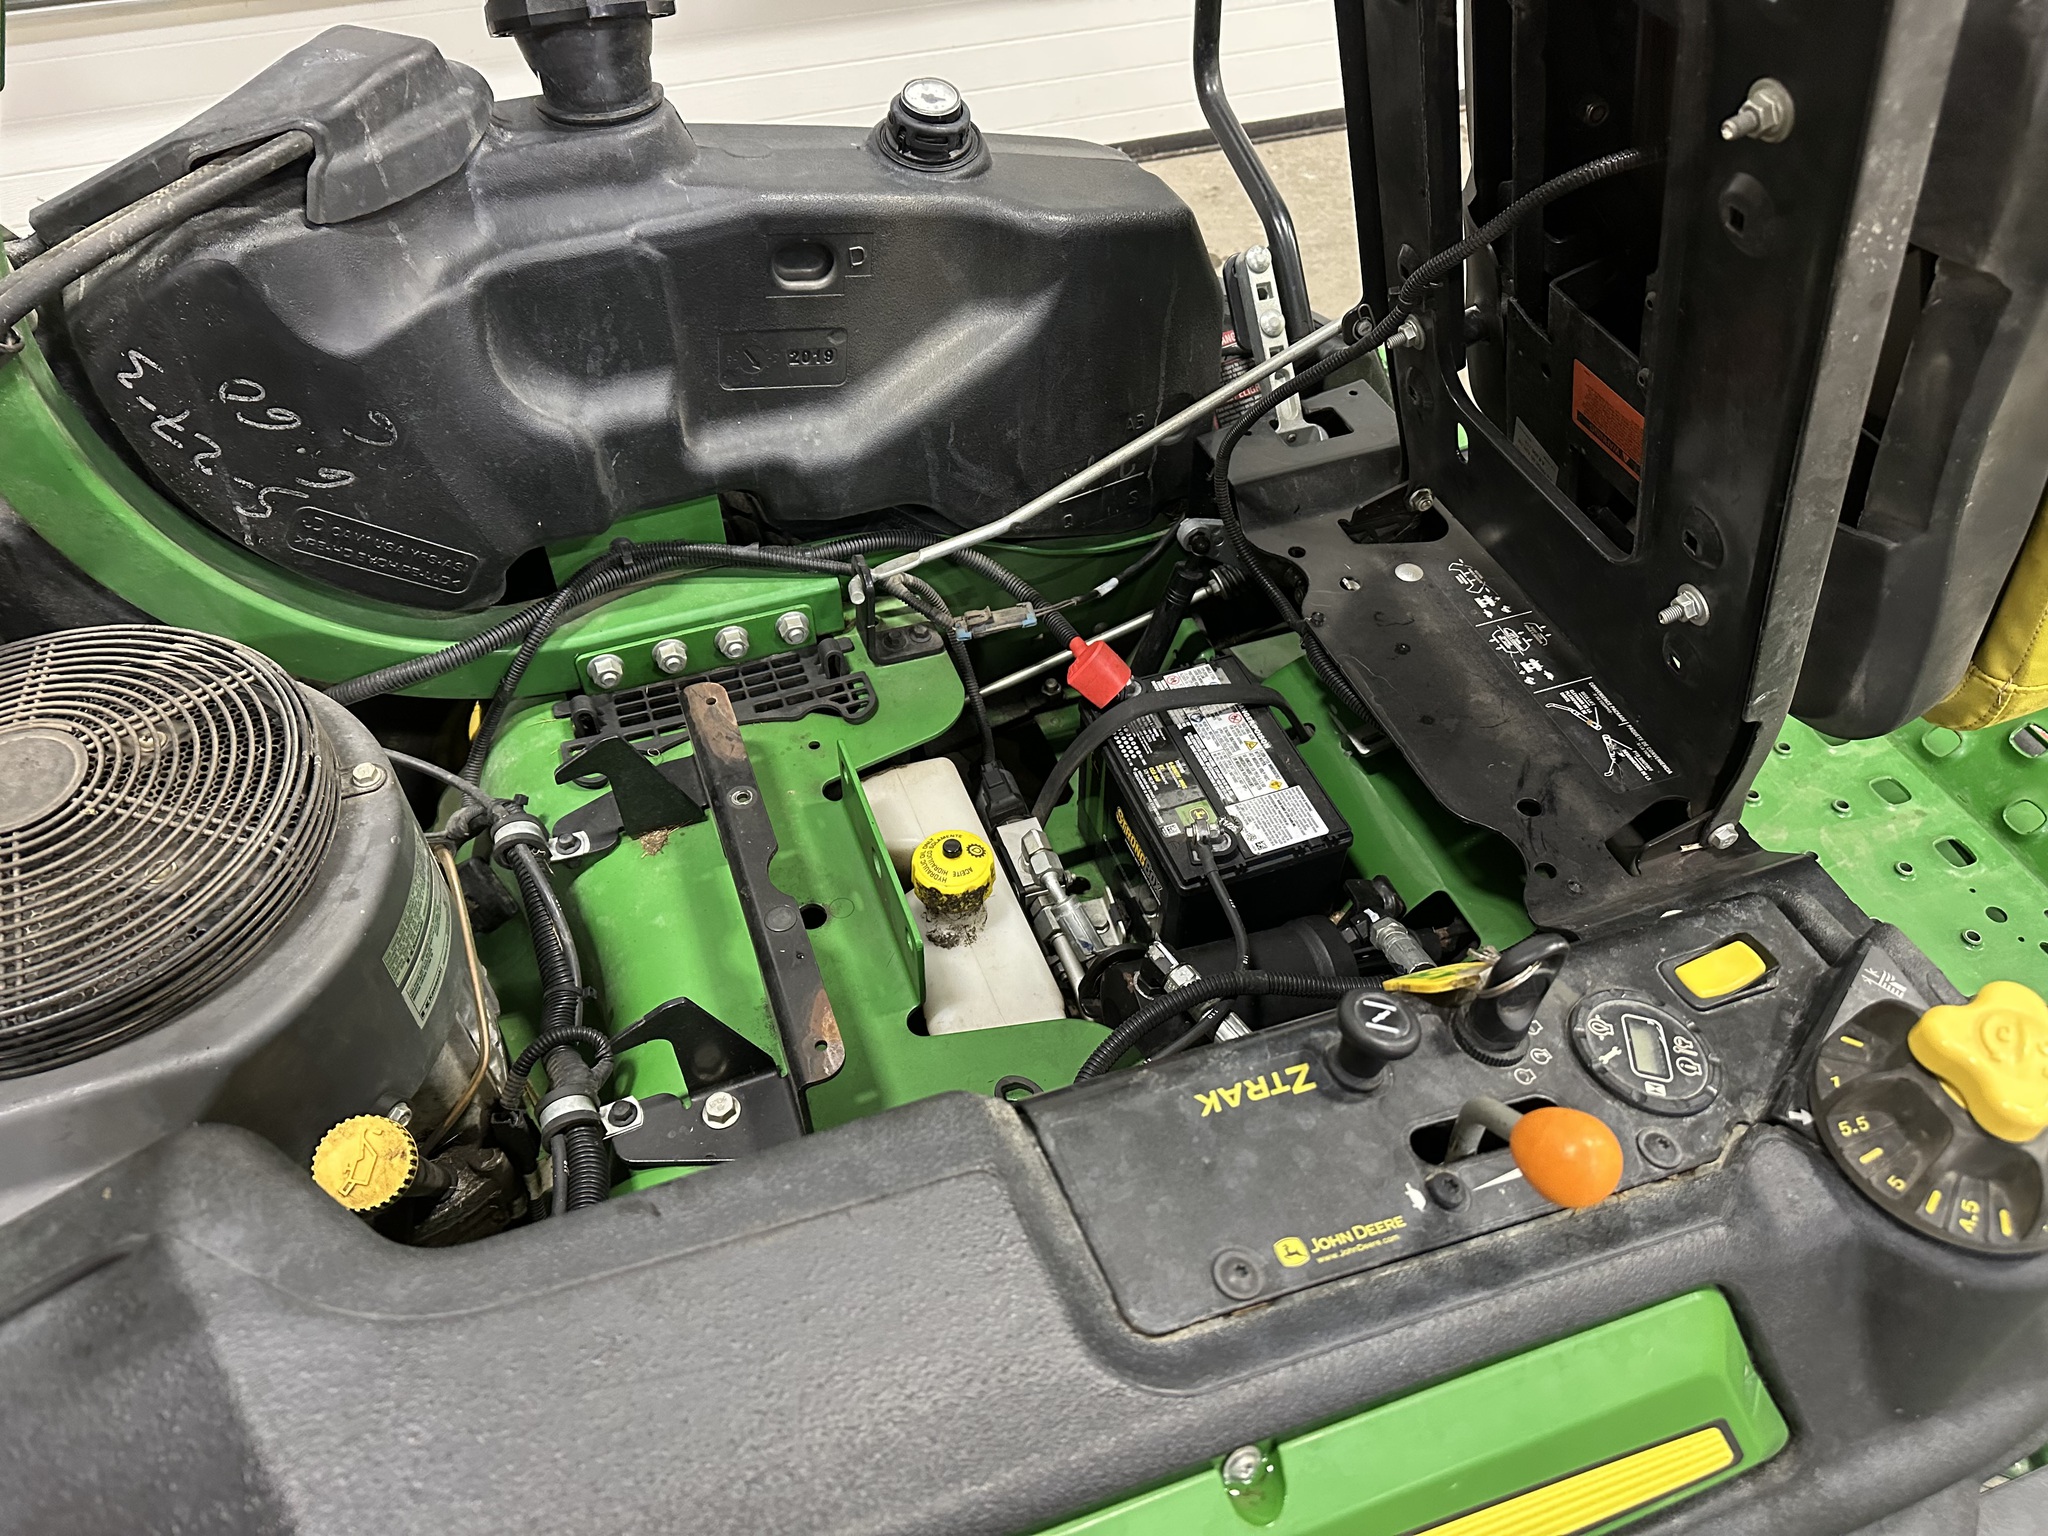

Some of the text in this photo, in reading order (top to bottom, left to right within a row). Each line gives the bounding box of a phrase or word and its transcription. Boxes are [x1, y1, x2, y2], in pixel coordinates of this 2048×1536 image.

[848, 245, 867, 266] D
[1222, 330, 1237, 346] ANG
[788, 349, 834, 365] 2019
[1239, 702, 1273, 750] ANGER/POISON
[922, 838, 934, 849] ONLY
[929, 834, 962, 849] SOLAMENTE
[920, 860, 947, 883] HYDRAULIC
[953, 867, 973, 877] ACEITE
[1194, 1062, 1317, 1117] ZTRAK
[1838, 1115, 1870, 1137] 5.5
[1887, 1175, 1907, 1193] 5
[1959, 1198, 1981, 1234] 4.5
[1310, 1214, 1408, 1255] JOHN DEERE
[1316, 1233, 1401, 1265] www.JohnDeere.com
